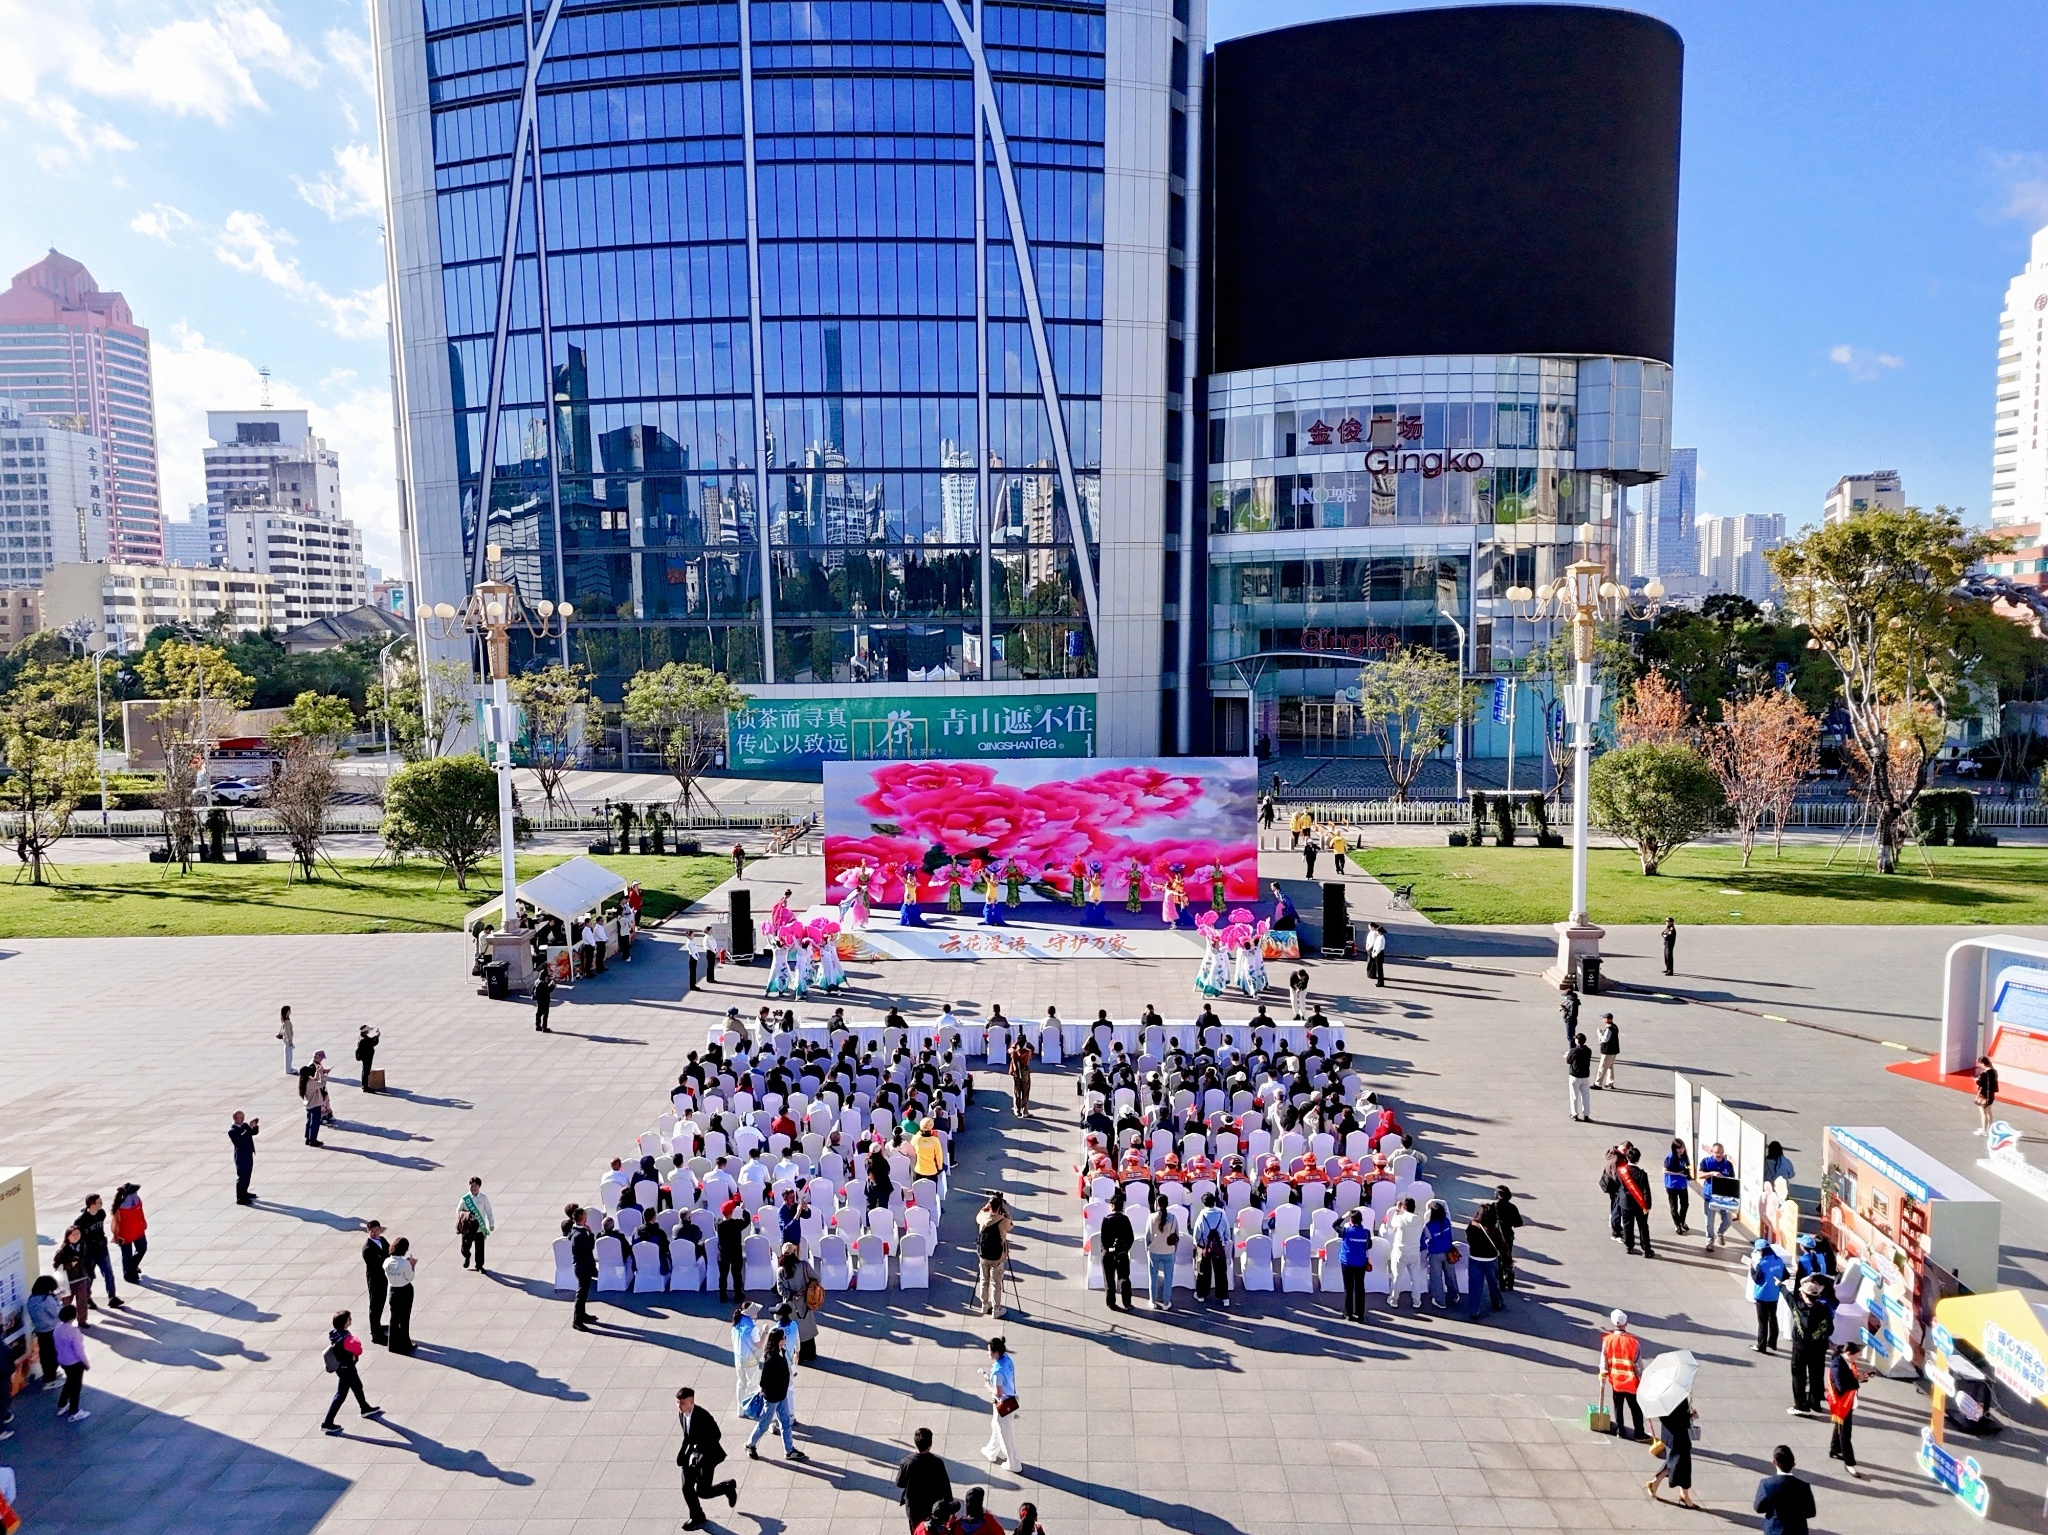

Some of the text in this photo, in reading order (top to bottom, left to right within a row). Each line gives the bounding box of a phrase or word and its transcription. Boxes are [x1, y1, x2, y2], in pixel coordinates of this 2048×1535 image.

[1307, 415, 1424, 445] 金俊广场
[736, 732, 848, 755] 传心以致远
